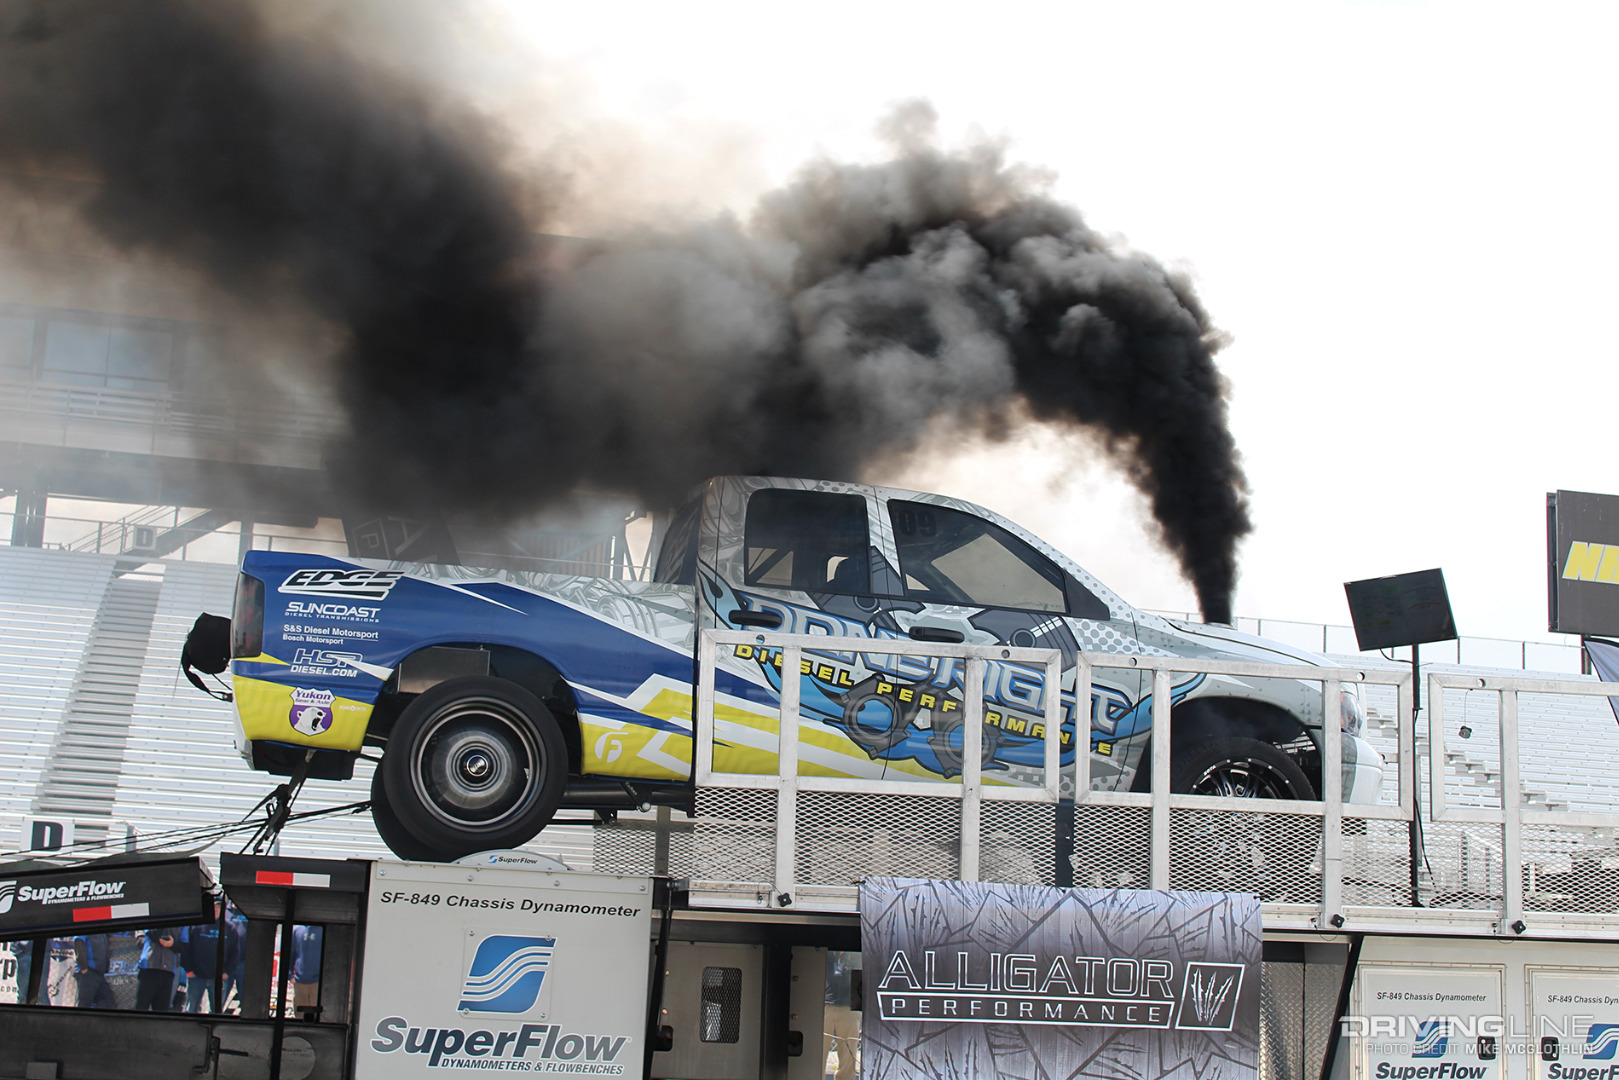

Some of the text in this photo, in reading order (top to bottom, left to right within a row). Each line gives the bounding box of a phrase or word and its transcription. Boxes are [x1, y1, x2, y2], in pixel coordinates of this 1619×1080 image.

[280, 569, 406, 590] EDGE
[285, 602, 381, 618] SUNCOAST
[316, 614, 380, 623] TRANSMISSIONS
[282, 633, 344, 645] Bosch Motorsport
[283, 624, 379, 639] S&S Diesel Motorsport
[290, 664, 359, 678] DIESEL.COM
[296, 690, 331, 700] Yukon
[877, 682, 1112, 755] PERFRMANE
[498, 856, 538, 865] SuperFlow
[17, 880, 125, 905] SuperFlow
[381, 891, 641, 918] SF-849 Chassis Dynamometer
[878, 950, 1175, 998] ALLIGATOR
[1376, 992, 1487, 1002] SF-849 Chassis Dynamometer
[1548, 995, 1573, 1003] SF-849
[1574, 996, 1603, 1004] Chassis
[892, 998, 1161, 1022] PERFORMANCE
[370, 1015, 628, 1069] SuperFlow
[441, 1058, 625, 1075] DYNAMOMETERS & FLOWBENCHES
[1375, 1062, 1487, 1080] SuperFlow
